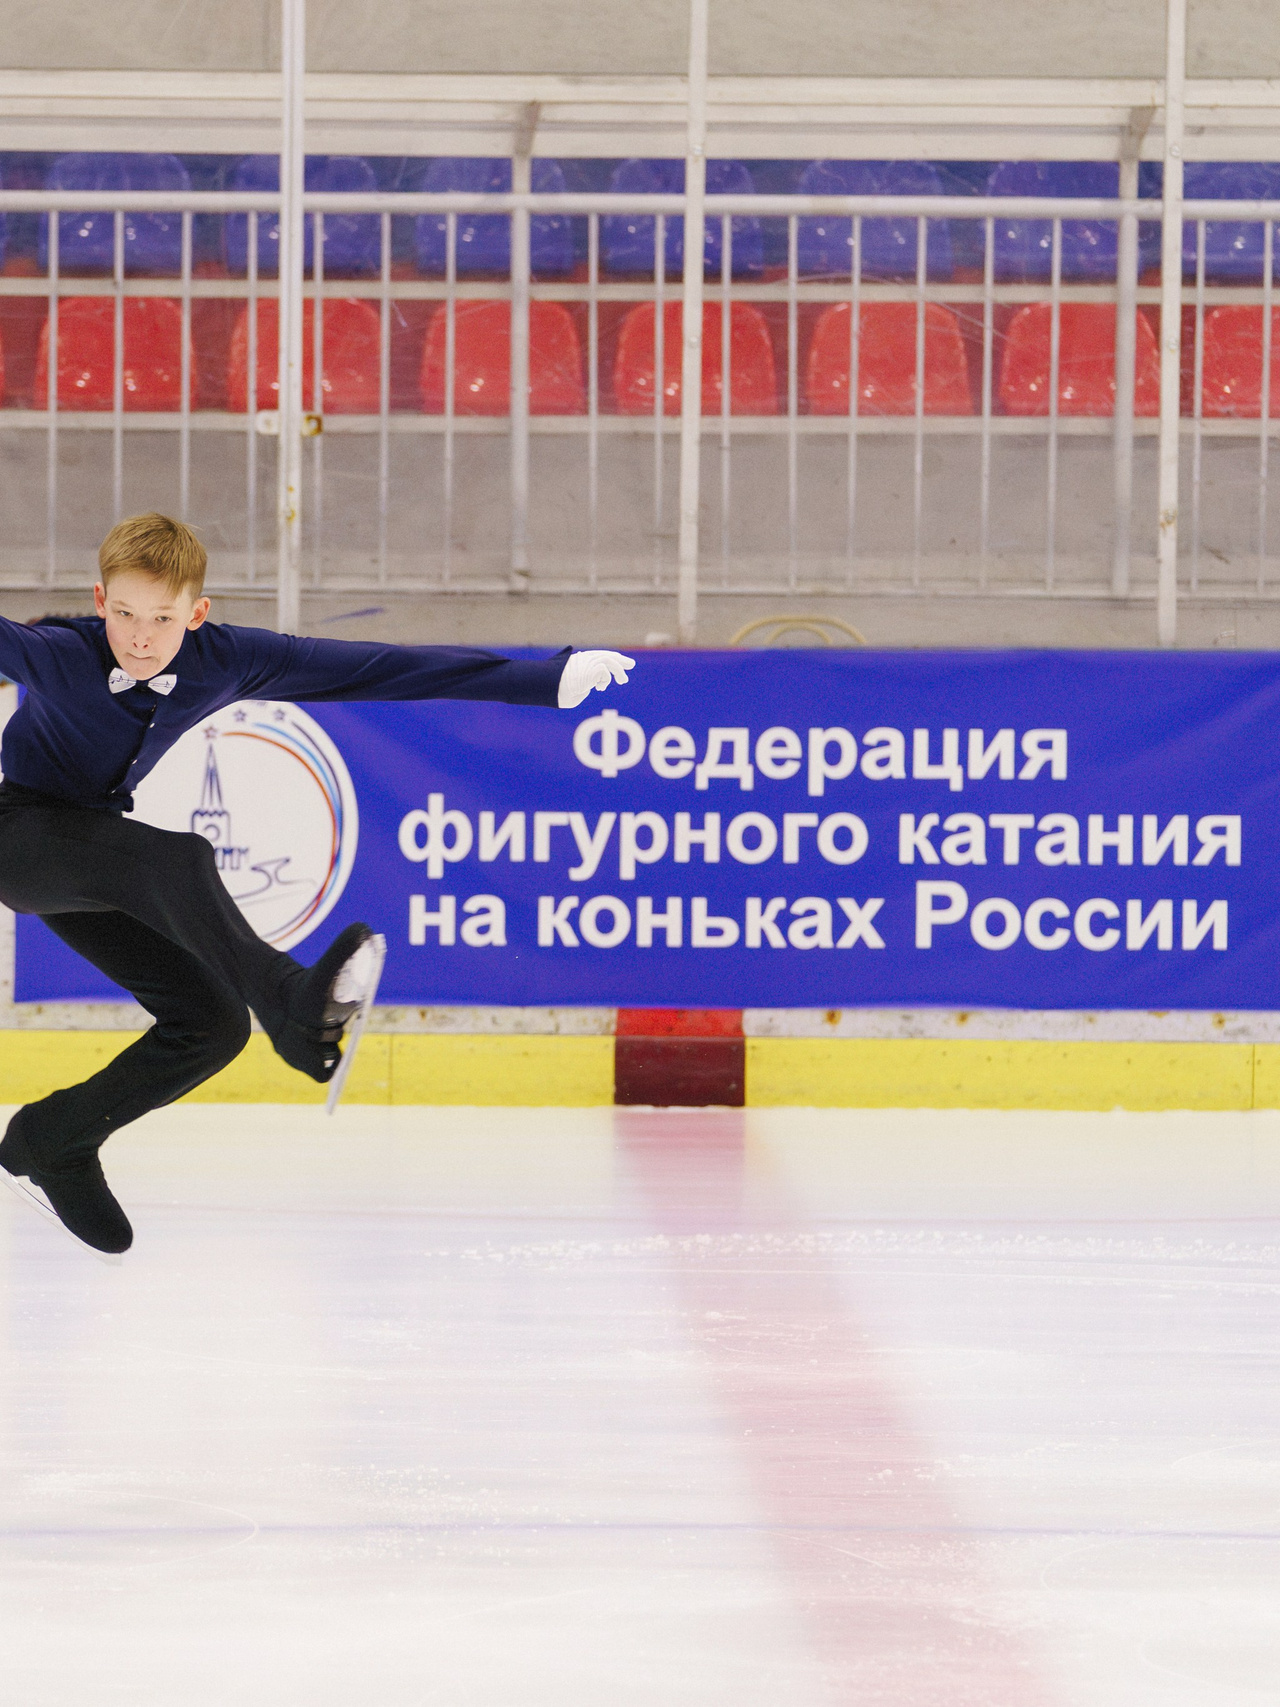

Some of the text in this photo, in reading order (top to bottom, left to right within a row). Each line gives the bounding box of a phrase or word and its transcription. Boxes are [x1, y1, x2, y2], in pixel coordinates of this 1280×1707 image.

[573, 708, 1068, 796] Федерация
[398, 793, 1242, 881] фигурного катания
[408, 880, 1229, 952] на коньках России
